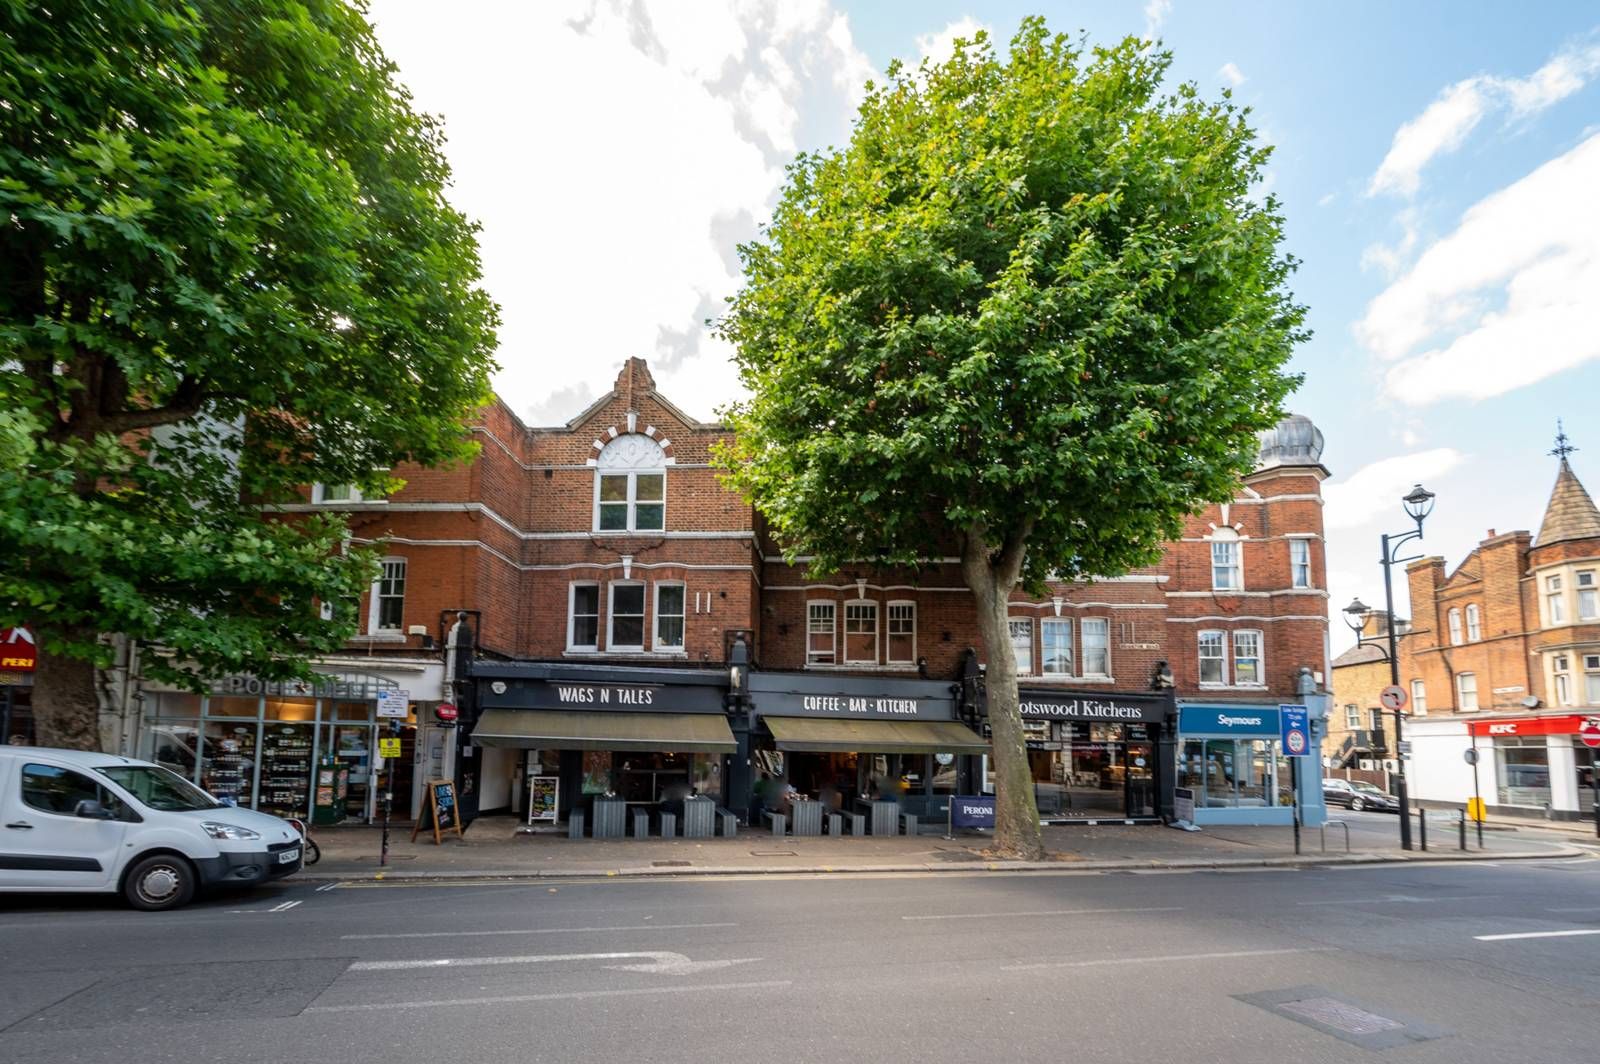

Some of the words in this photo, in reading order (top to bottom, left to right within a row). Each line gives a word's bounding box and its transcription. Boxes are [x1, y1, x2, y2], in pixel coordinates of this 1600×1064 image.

[558, 687, 594, 703] WAGS
[600, 688, 609, 703] N
[617, 689, 652, 704] TALES
[804, 696, 839, 712] COFFEE
[849, 698, 867, 713] BAR
[876, 699, 917, 714] KITCHEN
[1019, 700, 1078, 716] otswood
[1082, 701, 1142, 719] Kitchens
[1218, 714, 1261, 727] Seymours
[1489, 724, 1517, 733] KFC
[963, 805, 993, 815] PERONI
